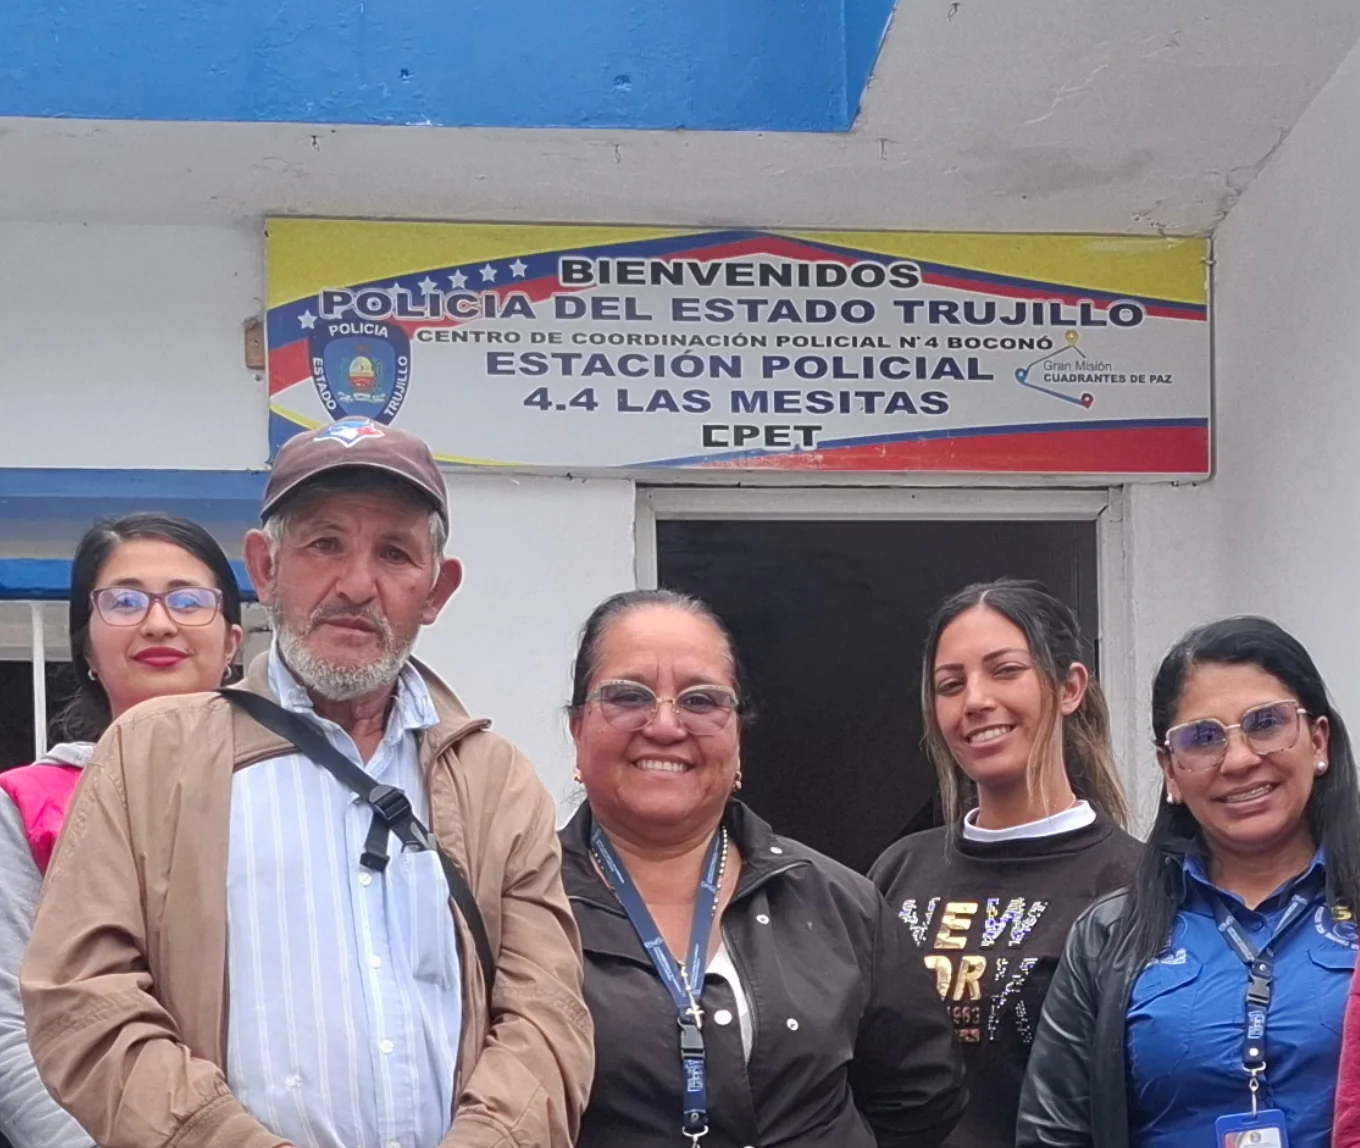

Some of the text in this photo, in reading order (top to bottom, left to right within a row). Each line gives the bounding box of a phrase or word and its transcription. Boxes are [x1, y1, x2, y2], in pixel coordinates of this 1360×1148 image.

[561, 259, 920, 288] BIENVENIDOS
[322, 290, 1145, 327] POLICIA DEL ESTADO TRUJILLO
[328, 322, 389, 338] POLICIA
[417, 329, 521, 344] CENTRO
[530, 332, 563, 345] DE
[572, 332, 767, 348] COORDINACIÓN
[776, 335, 891, 349] POLICIAL
[947, 335, 1053, 350] BOCONÓ
[487, 349, 995, 381] ESTACIÓN POLICIAL
[1043, 360, 1112, 372] Gran Misión
[1043, 373, 1173, 384] CUADRANTES DE PAZ
[313, 357, 337, 410] ESTADO
[383, 356, 408, 416] TRUJILLO
[523, 386, 950, 415] 4.4 LAS MESITAS
[702, 424, 822, 448] CPET
[924, 954, 1039, 1042] ORK
